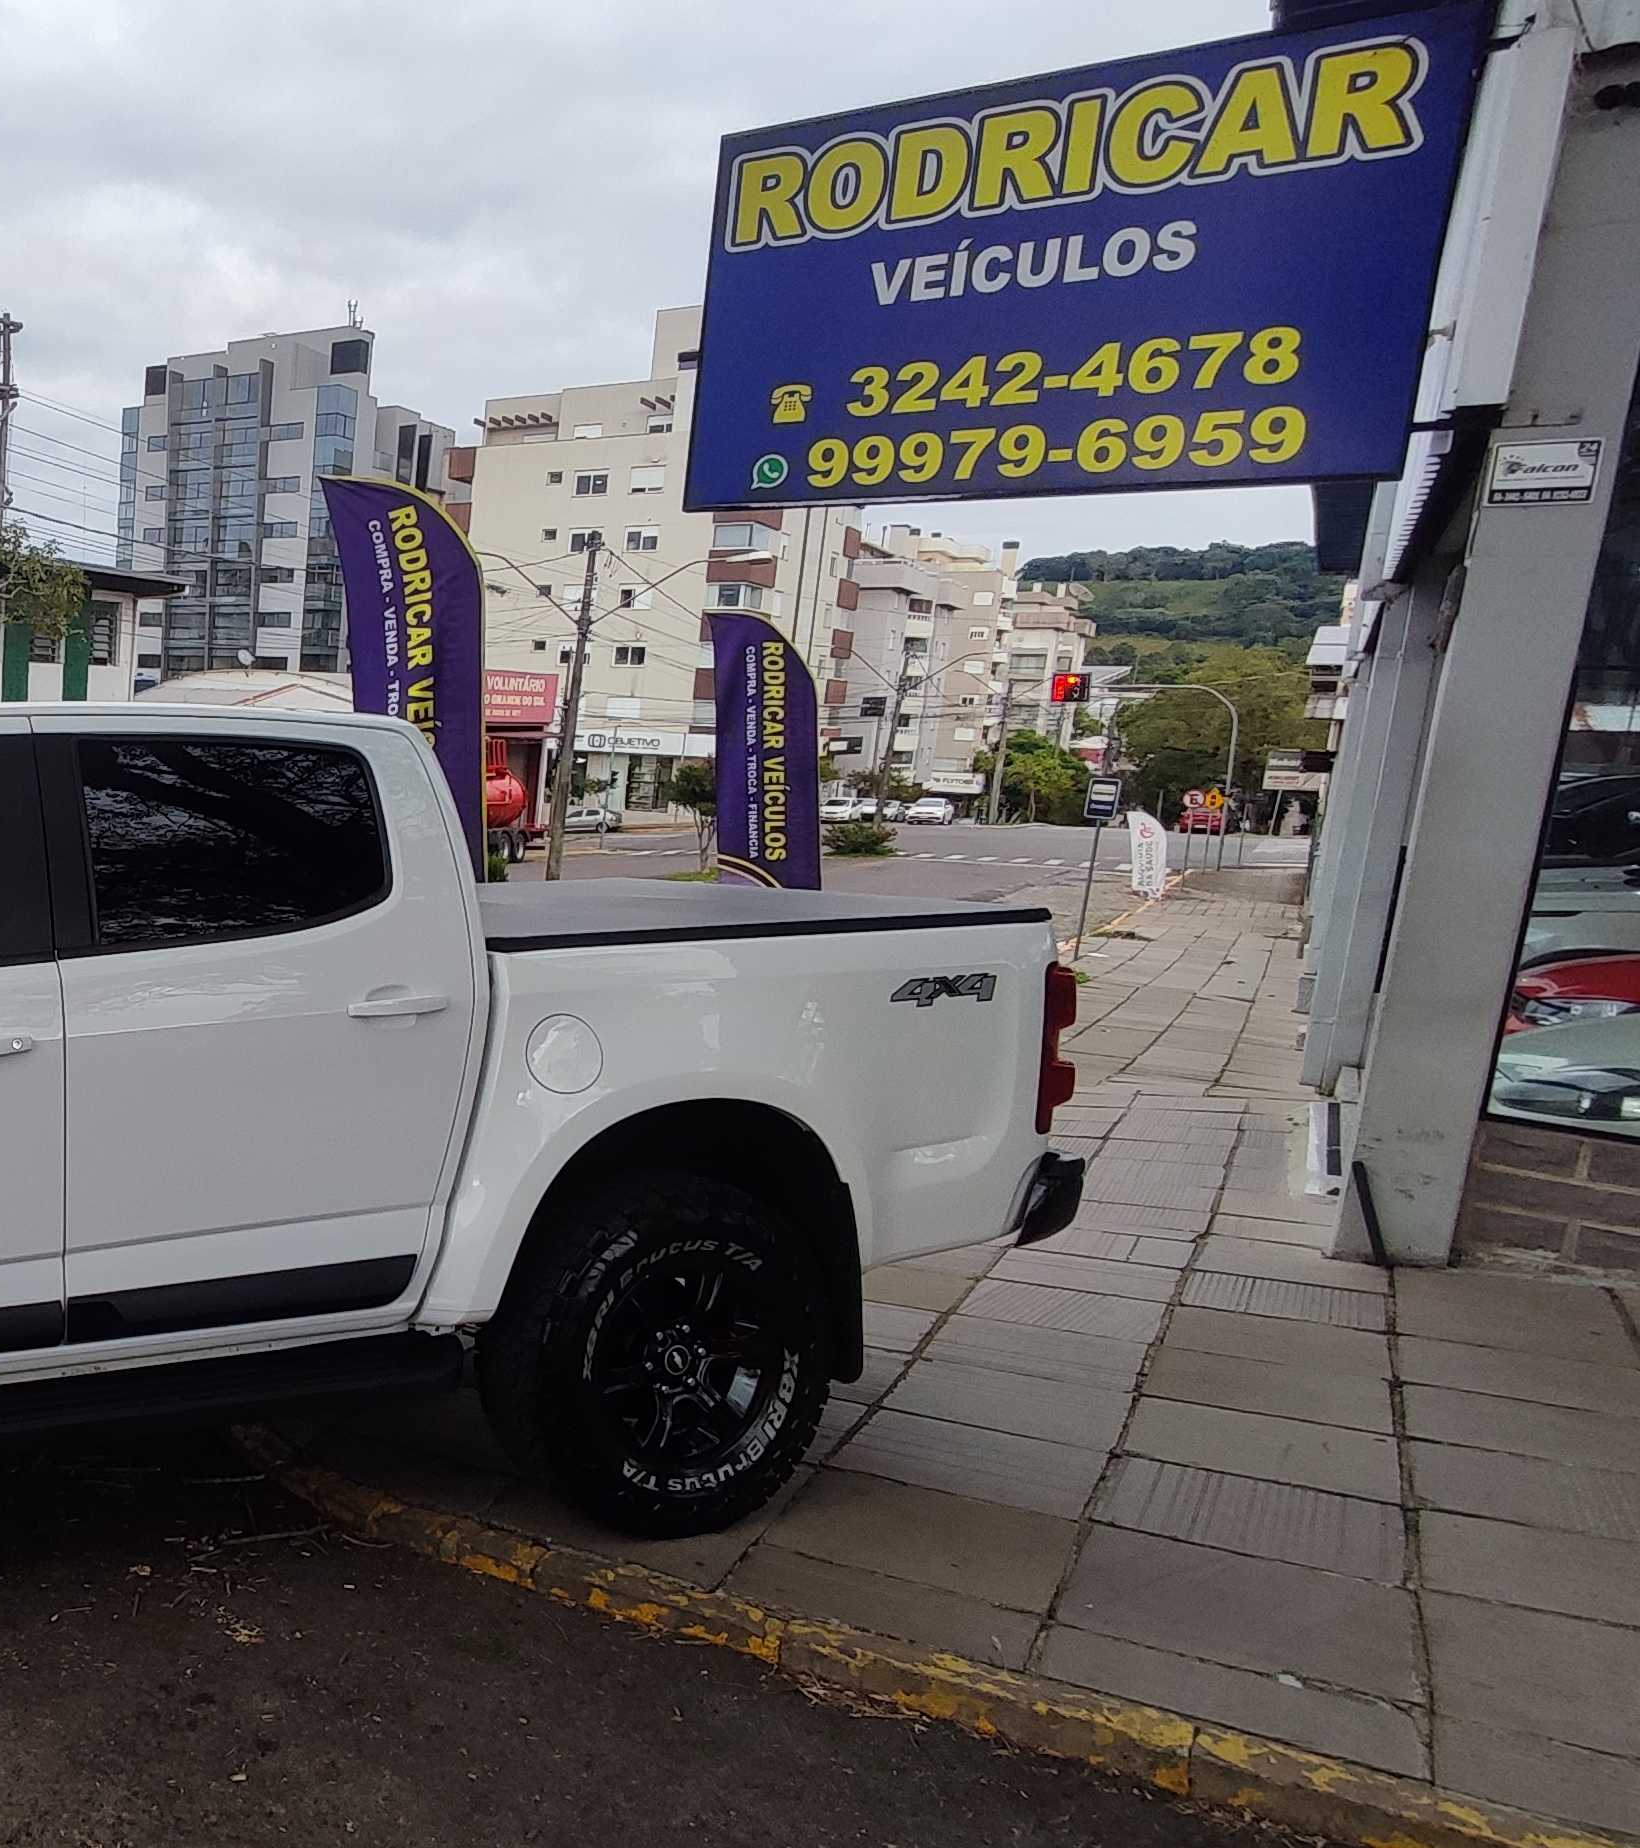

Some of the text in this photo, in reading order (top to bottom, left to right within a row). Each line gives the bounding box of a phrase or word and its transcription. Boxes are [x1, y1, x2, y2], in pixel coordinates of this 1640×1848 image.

[726, 34, 1430, 253] RODRICAR
[869, 219, 1198, 307] VEÍCULOS
[845, 325, 1302, 418] 3242-4678
[805, 405, 1309, 489] 99979-6959
[368, 519, 395, 594] COMPRA
[387, 505, 435, 671] RODRICAR
[383, 606, 399, 668] VENDA
[387, 679, 400, 719] TRO
[487, 675, 545, 692] VOLUNTÁRIO
[745, 646, 756, 697] COMPRA
[607, 736, 660, 747] OBJETIVO
[745, 705, 757, 746] VENDA
[762, 642, 791, 861] RODRICAR VEÍCULOS
[746, 755, 758, 796] TROCA
[748, 804, 759, 859] FINANCIA
[761, 1347, 800, 1441] XBRI
[621, 1459, 660, 1492] T/A
